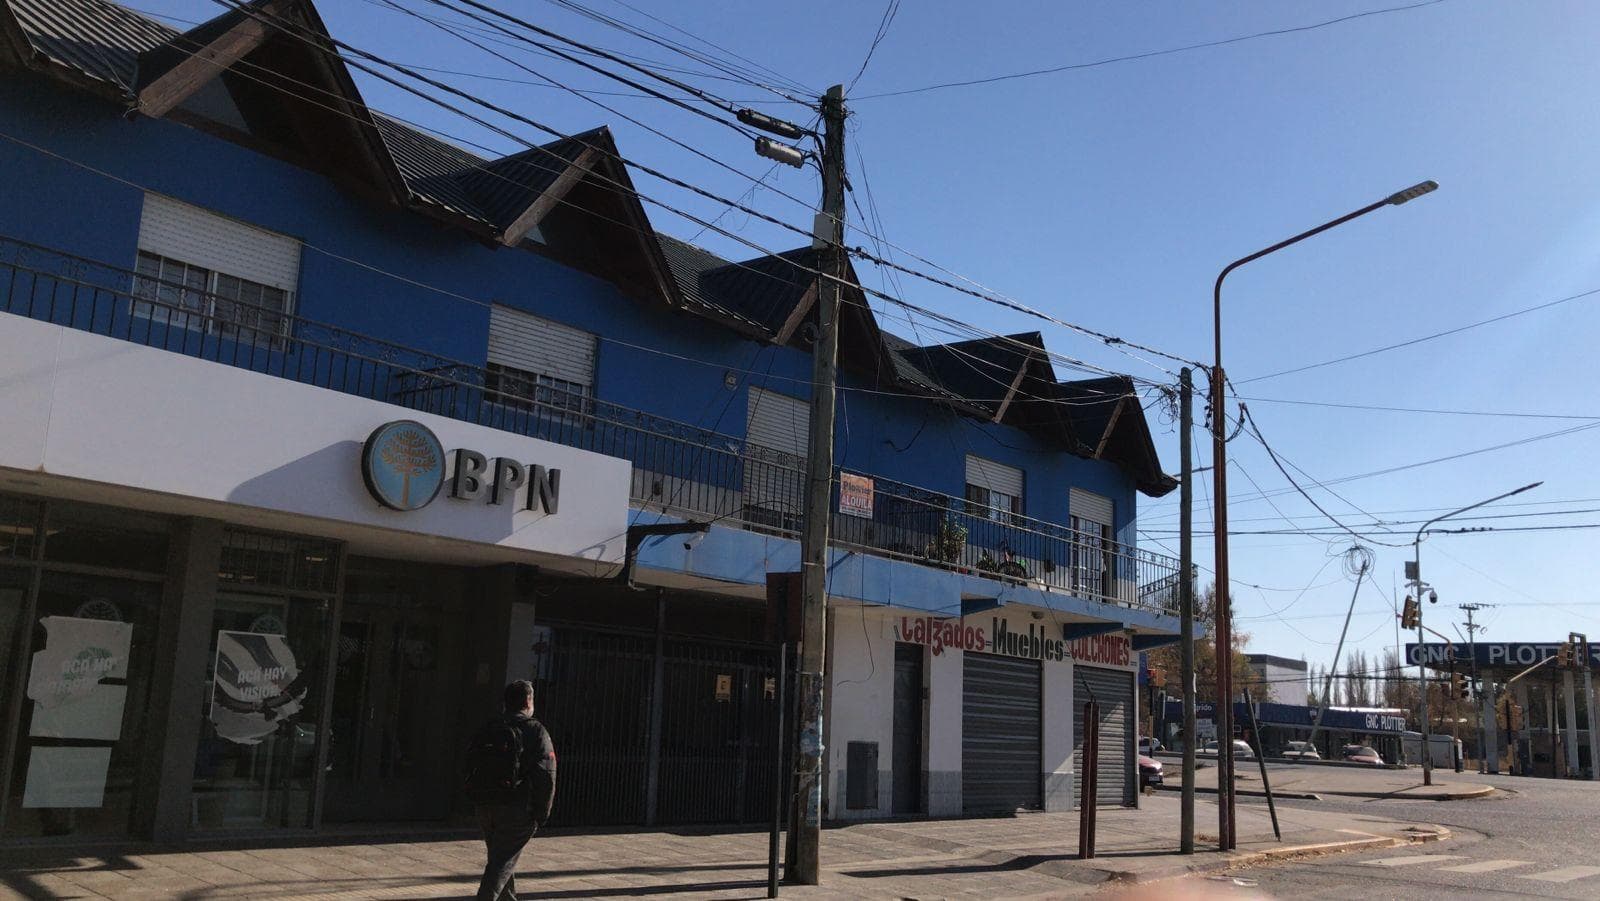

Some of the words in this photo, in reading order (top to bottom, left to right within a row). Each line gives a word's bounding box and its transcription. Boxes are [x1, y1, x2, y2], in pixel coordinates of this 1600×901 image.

[451, 448, 561, 515] BPN
[841, 494, 874, 511] ALQUILA
[901, 616, 985, 656] Calzados
[992, 617, 1065, 661] Muebles
[1071, 634, 1130, 666] COLCHONES
[1410, 645, 1459, 665] GNC
[264, 666, 287, 681] HAY
[1365, 713, 1379, 729] GNC
